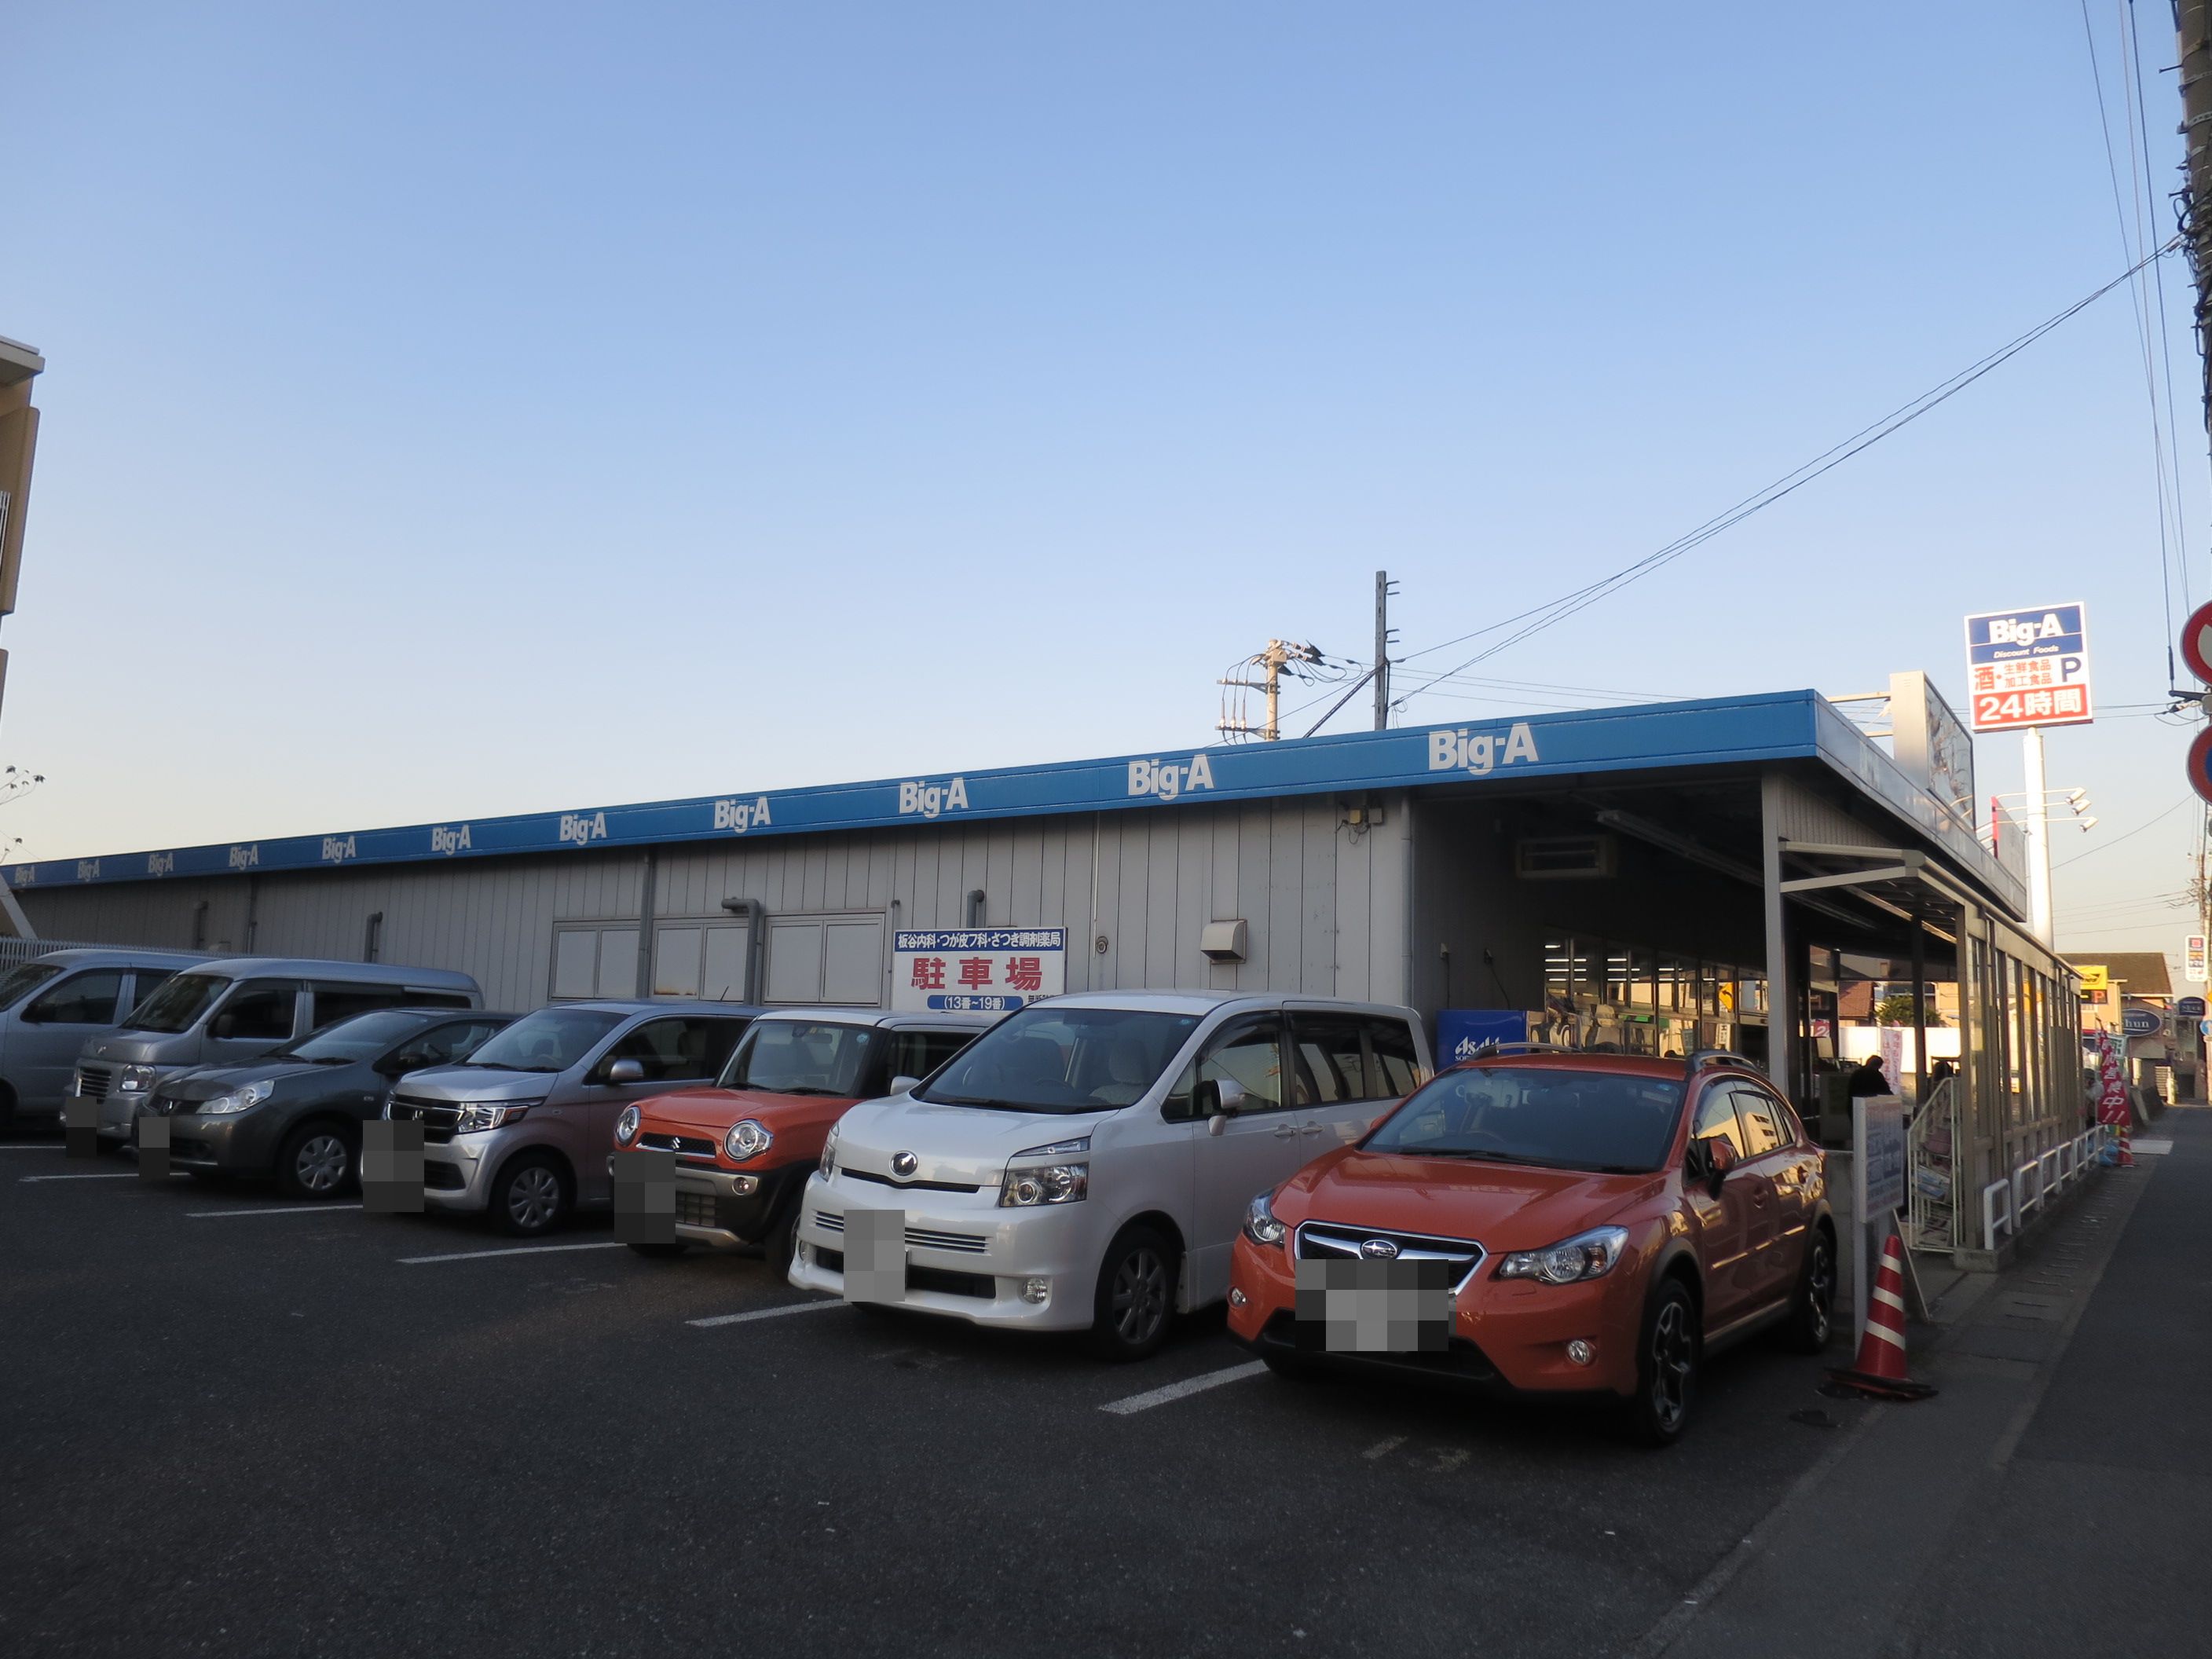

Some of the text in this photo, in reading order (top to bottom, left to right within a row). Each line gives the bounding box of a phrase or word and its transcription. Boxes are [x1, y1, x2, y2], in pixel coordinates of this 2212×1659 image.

[1989, 613, 2064, 646] Big-A
[1994, 645, 2060, 658] Discount Foods
[2004, 659, 2051, 674] 生鮮食品
[2060, 657, 2082, 683] P
[2005, 672, 2053, 688] 加工食品
[1979, 688, 2082, 721] 24時間
[910, 957, 1042, 991] 駐車場
[2123, 1019, 2149, 1027] hun
